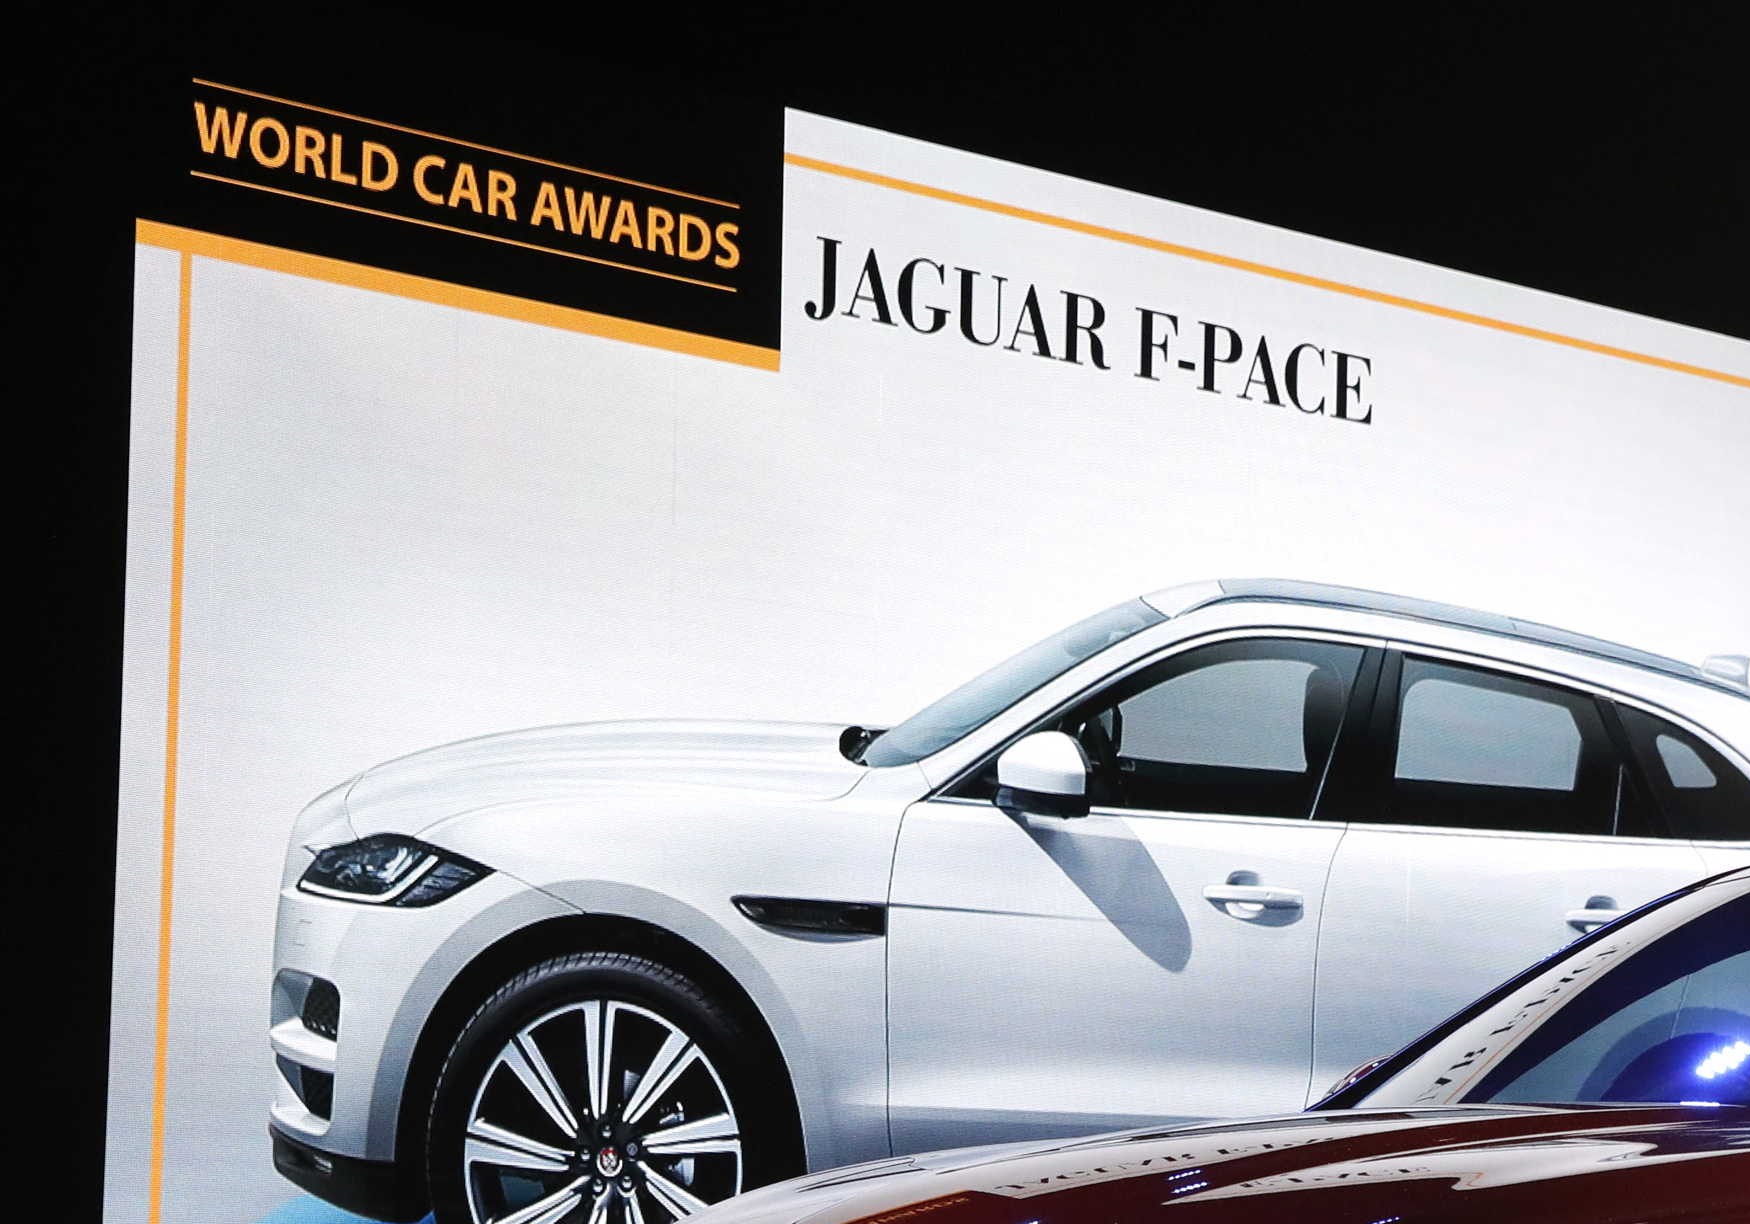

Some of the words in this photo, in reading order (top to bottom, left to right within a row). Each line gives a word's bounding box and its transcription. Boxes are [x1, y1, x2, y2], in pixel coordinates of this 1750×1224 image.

[194, 101, 399, 192] WORLD
[413, 155, 517, 222] CAR
[530, 181, 741, 270] AWARDS
[804, 235, 1112, 370] JAGUAR
[1133, 306, 1372, 425] F-PACE
